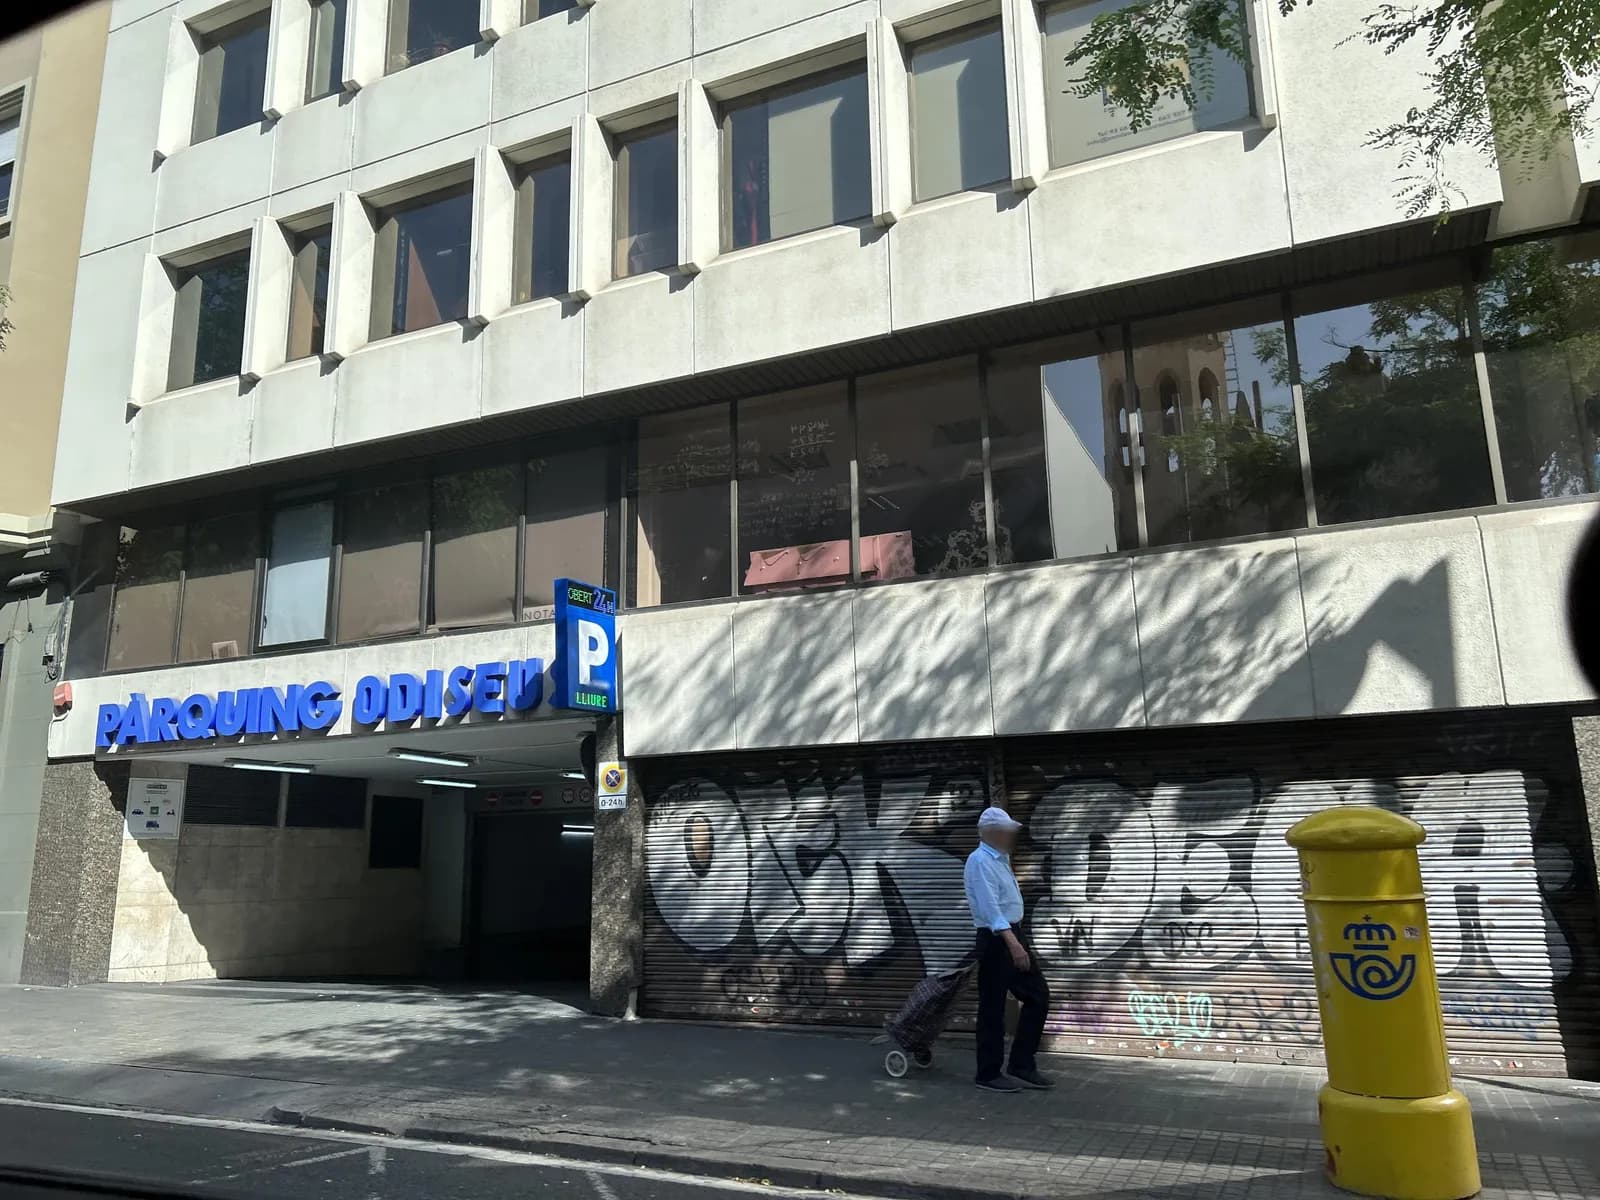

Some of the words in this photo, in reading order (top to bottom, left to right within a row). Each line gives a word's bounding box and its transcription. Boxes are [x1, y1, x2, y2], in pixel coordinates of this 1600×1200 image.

[568, 587, 593, 604] OBERT
[577, 619, 609, 685] P
[96, 681, 342, 747] PÀRQUING
[353, 658, 543, 724] ODISEU
[576, 691, 607, 708] LLIURE
